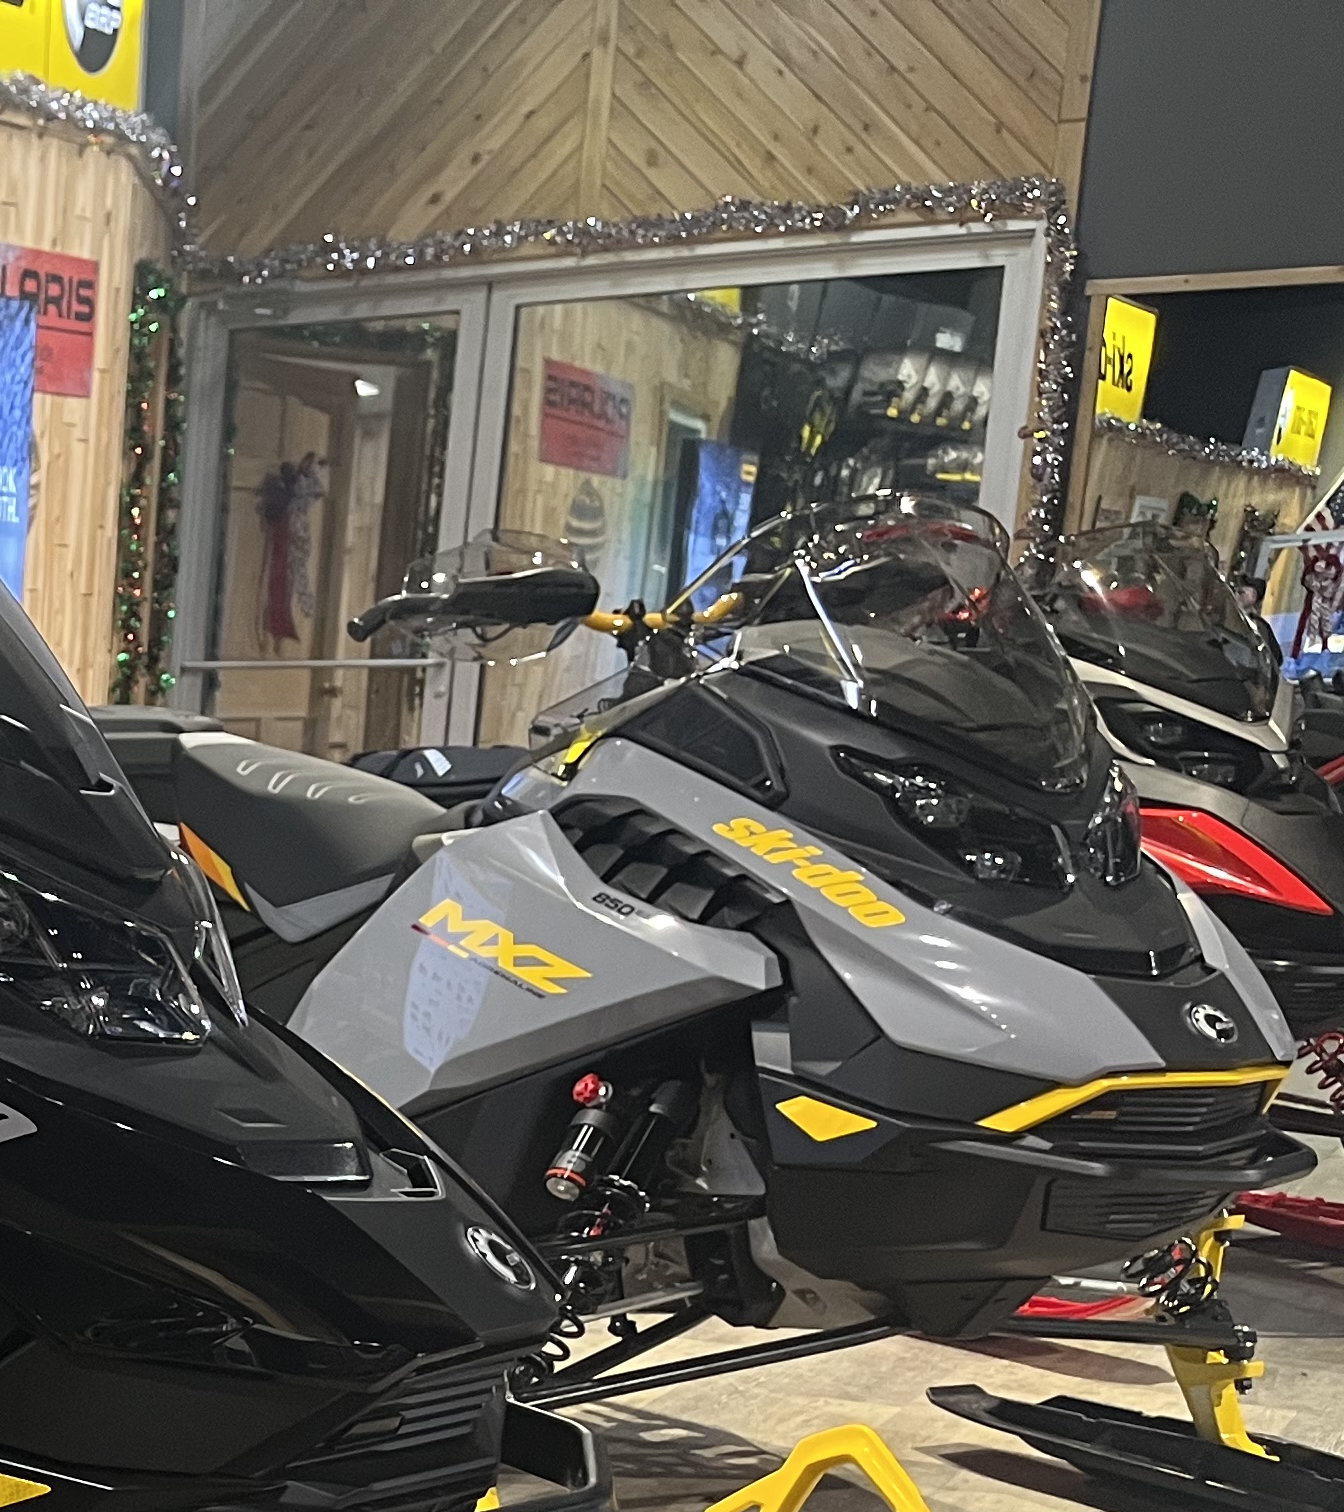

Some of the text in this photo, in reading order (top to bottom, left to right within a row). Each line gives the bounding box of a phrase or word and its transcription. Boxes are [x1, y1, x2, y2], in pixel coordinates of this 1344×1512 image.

[591, 892, 635, 916] 850
[712, 817, 906, 928] ski-doo
[418, 898, 593, 994] MXZ
